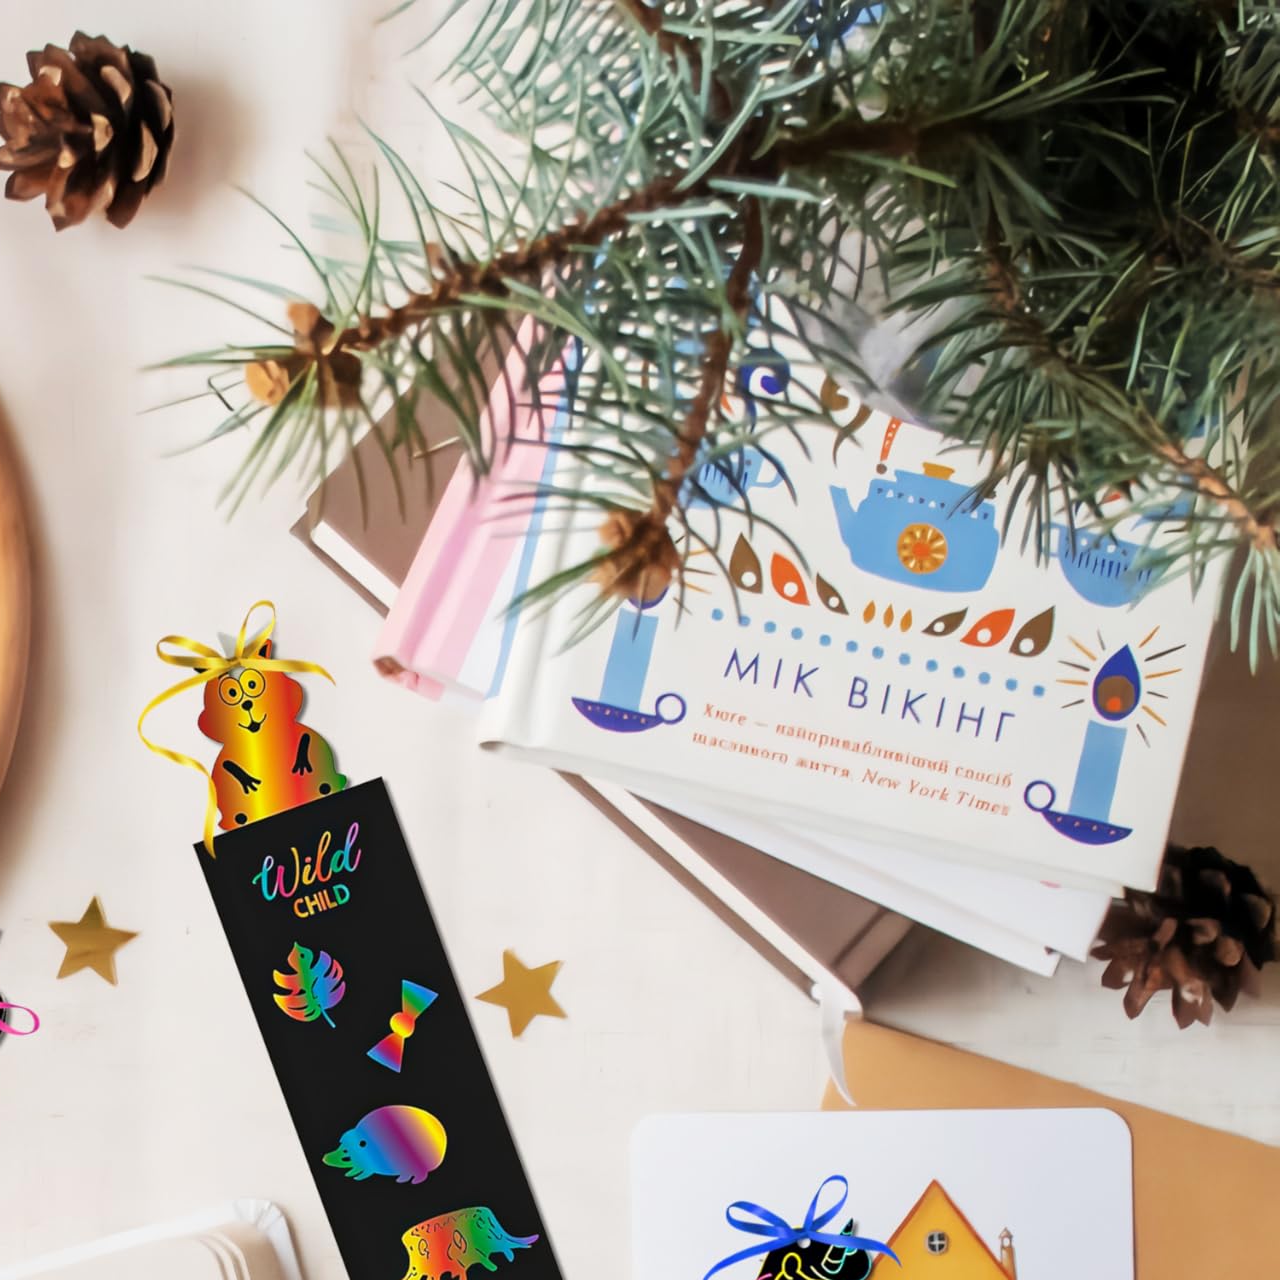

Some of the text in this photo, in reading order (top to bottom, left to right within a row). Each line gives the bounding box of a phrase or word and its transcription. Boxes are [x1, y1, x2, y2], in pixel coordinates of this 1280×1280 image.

[723, 648, 1015, 742] МІК ВІКІНГ
[691, 731, 789, 764] щасливого
[862, 767, 901, 790] New
[908, 778, 951, 802] York
[957, 790, 1011, 817] Times
[775, 723, 950, 774] найпривабливіший
[955, 764, 1014, 788] спосіб
[251, 821, 363, 901] Wild
[293, 883, 351, 919] CHILD
